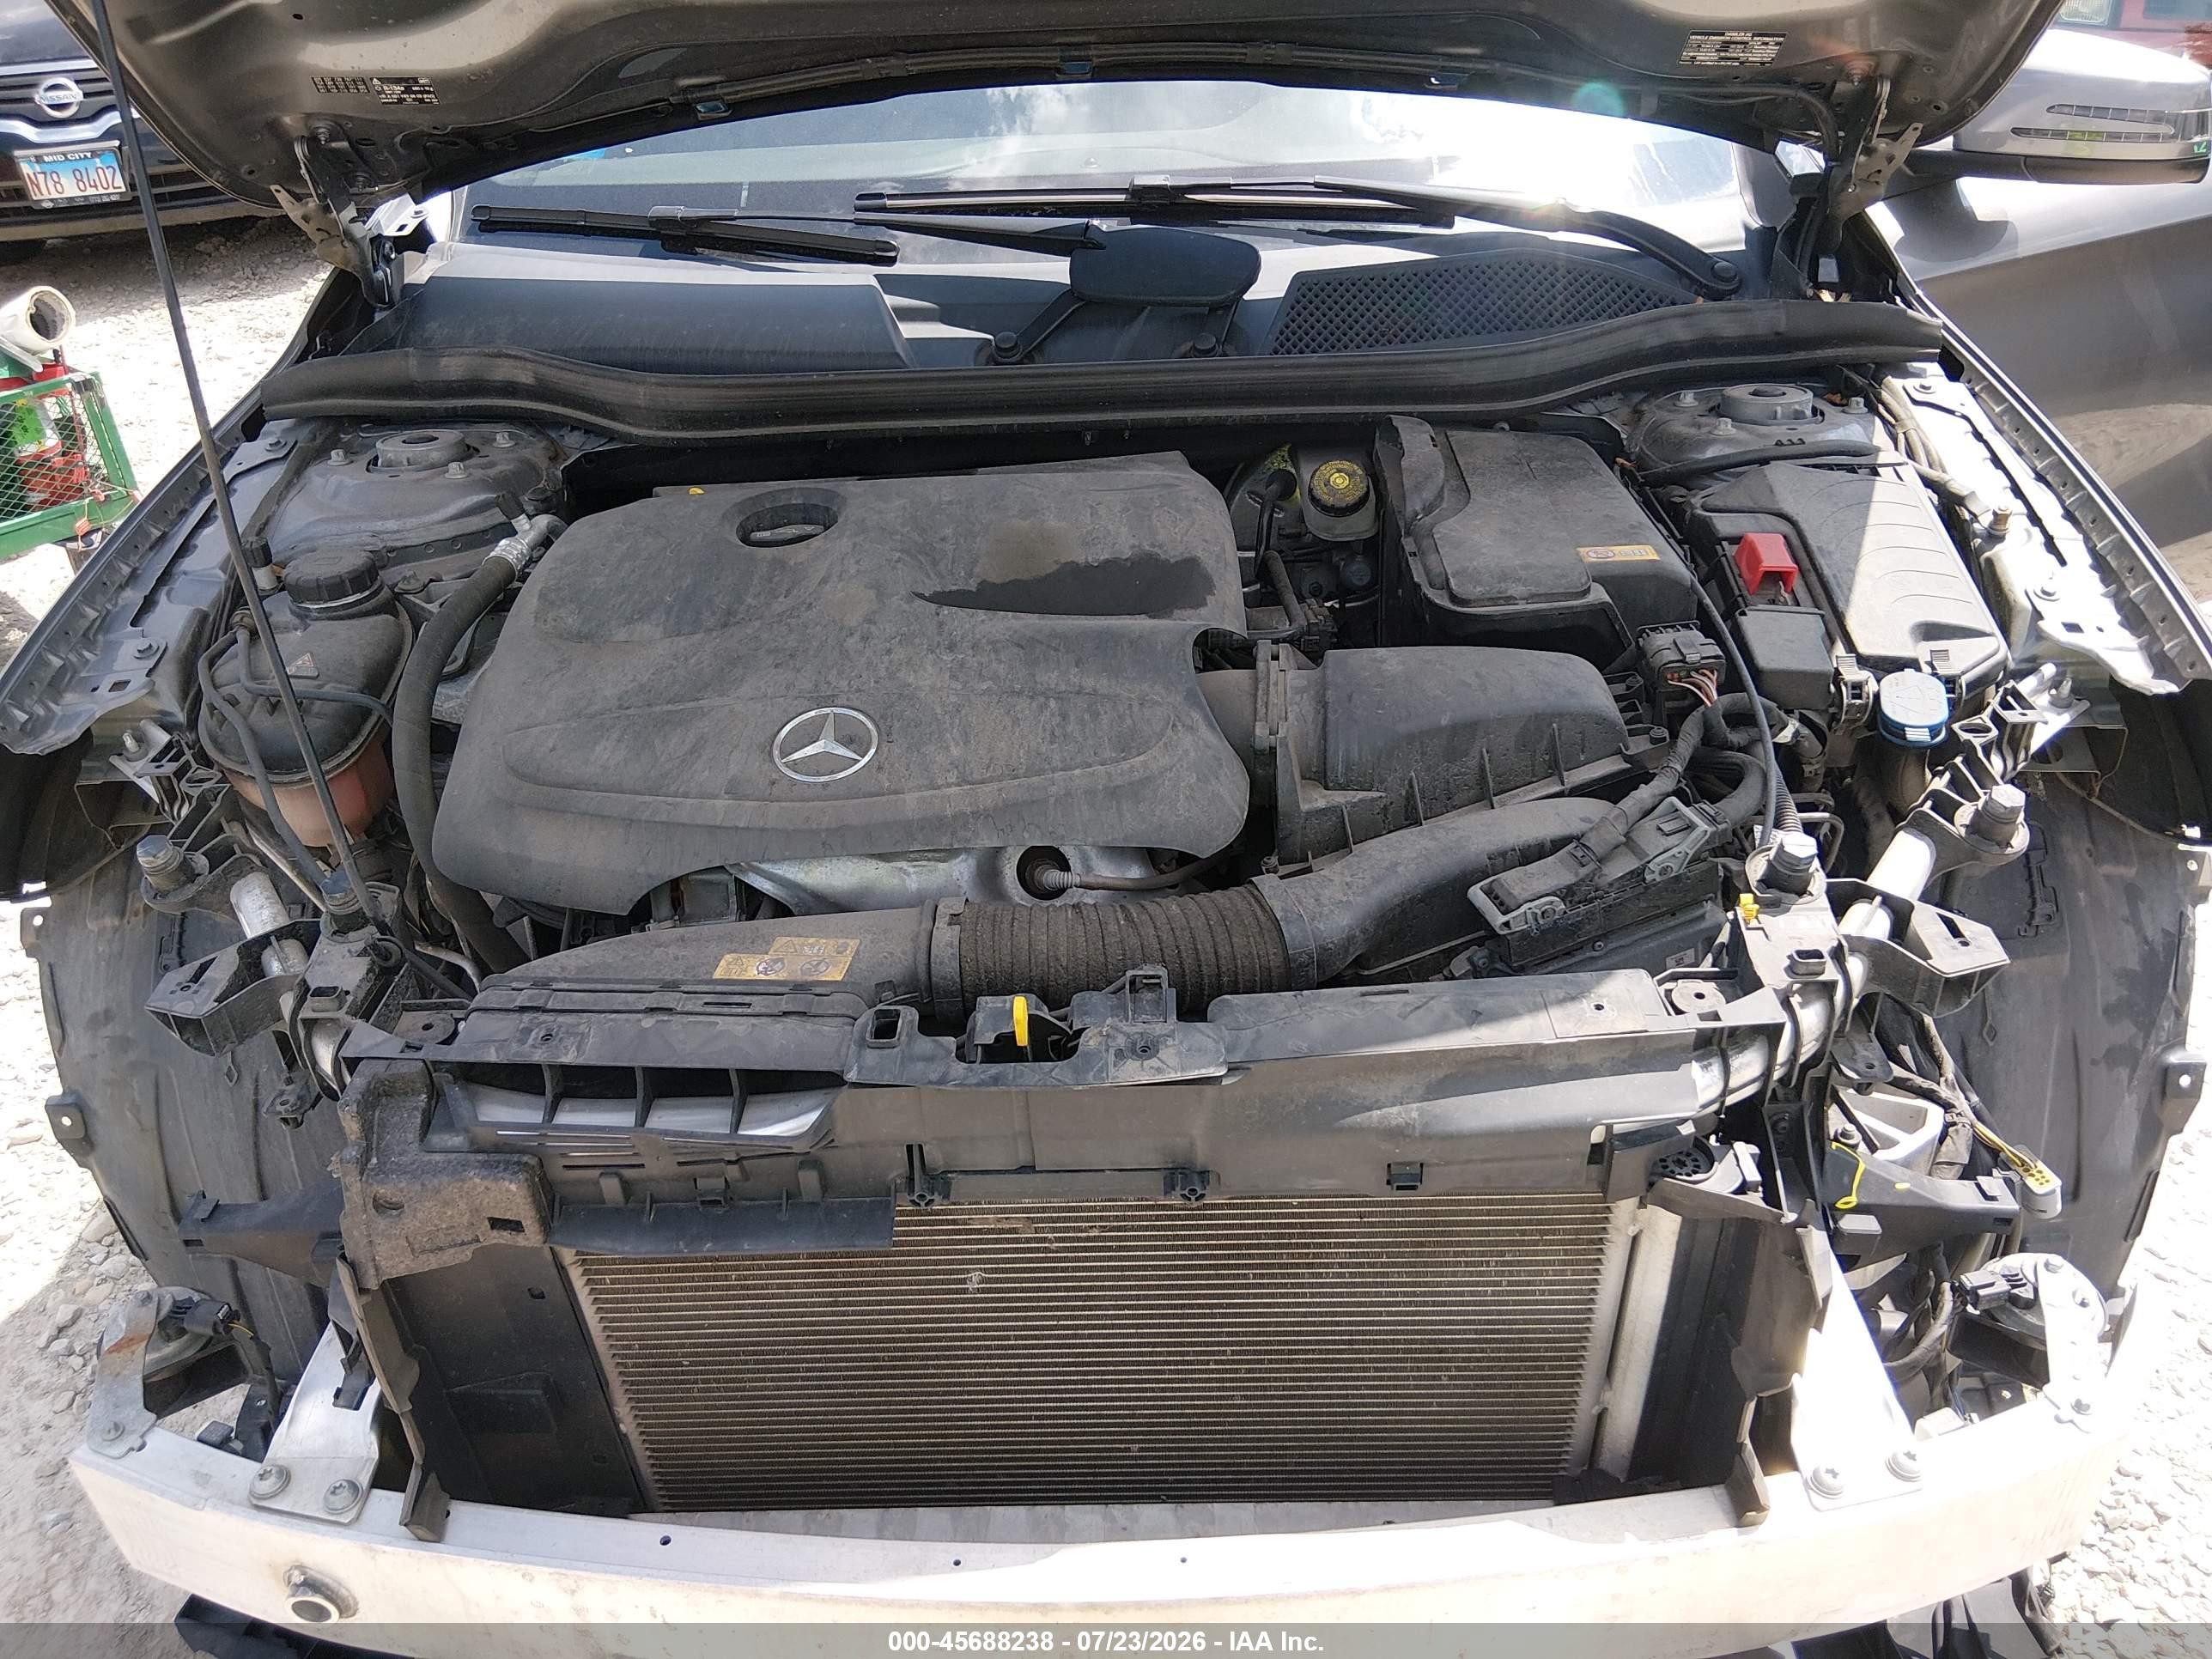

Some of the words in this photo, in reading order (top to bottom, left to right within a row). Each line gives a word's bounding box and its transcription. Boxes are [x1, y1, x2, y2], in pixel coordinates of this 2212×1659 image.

[40, 94, 77, 102] NISSAN
[43, 155, 65, 163] MID
[67, 152, 93, 161] CITY
[27, 171, 64, 197] N78
[73, 166, 122, 192] 8402
